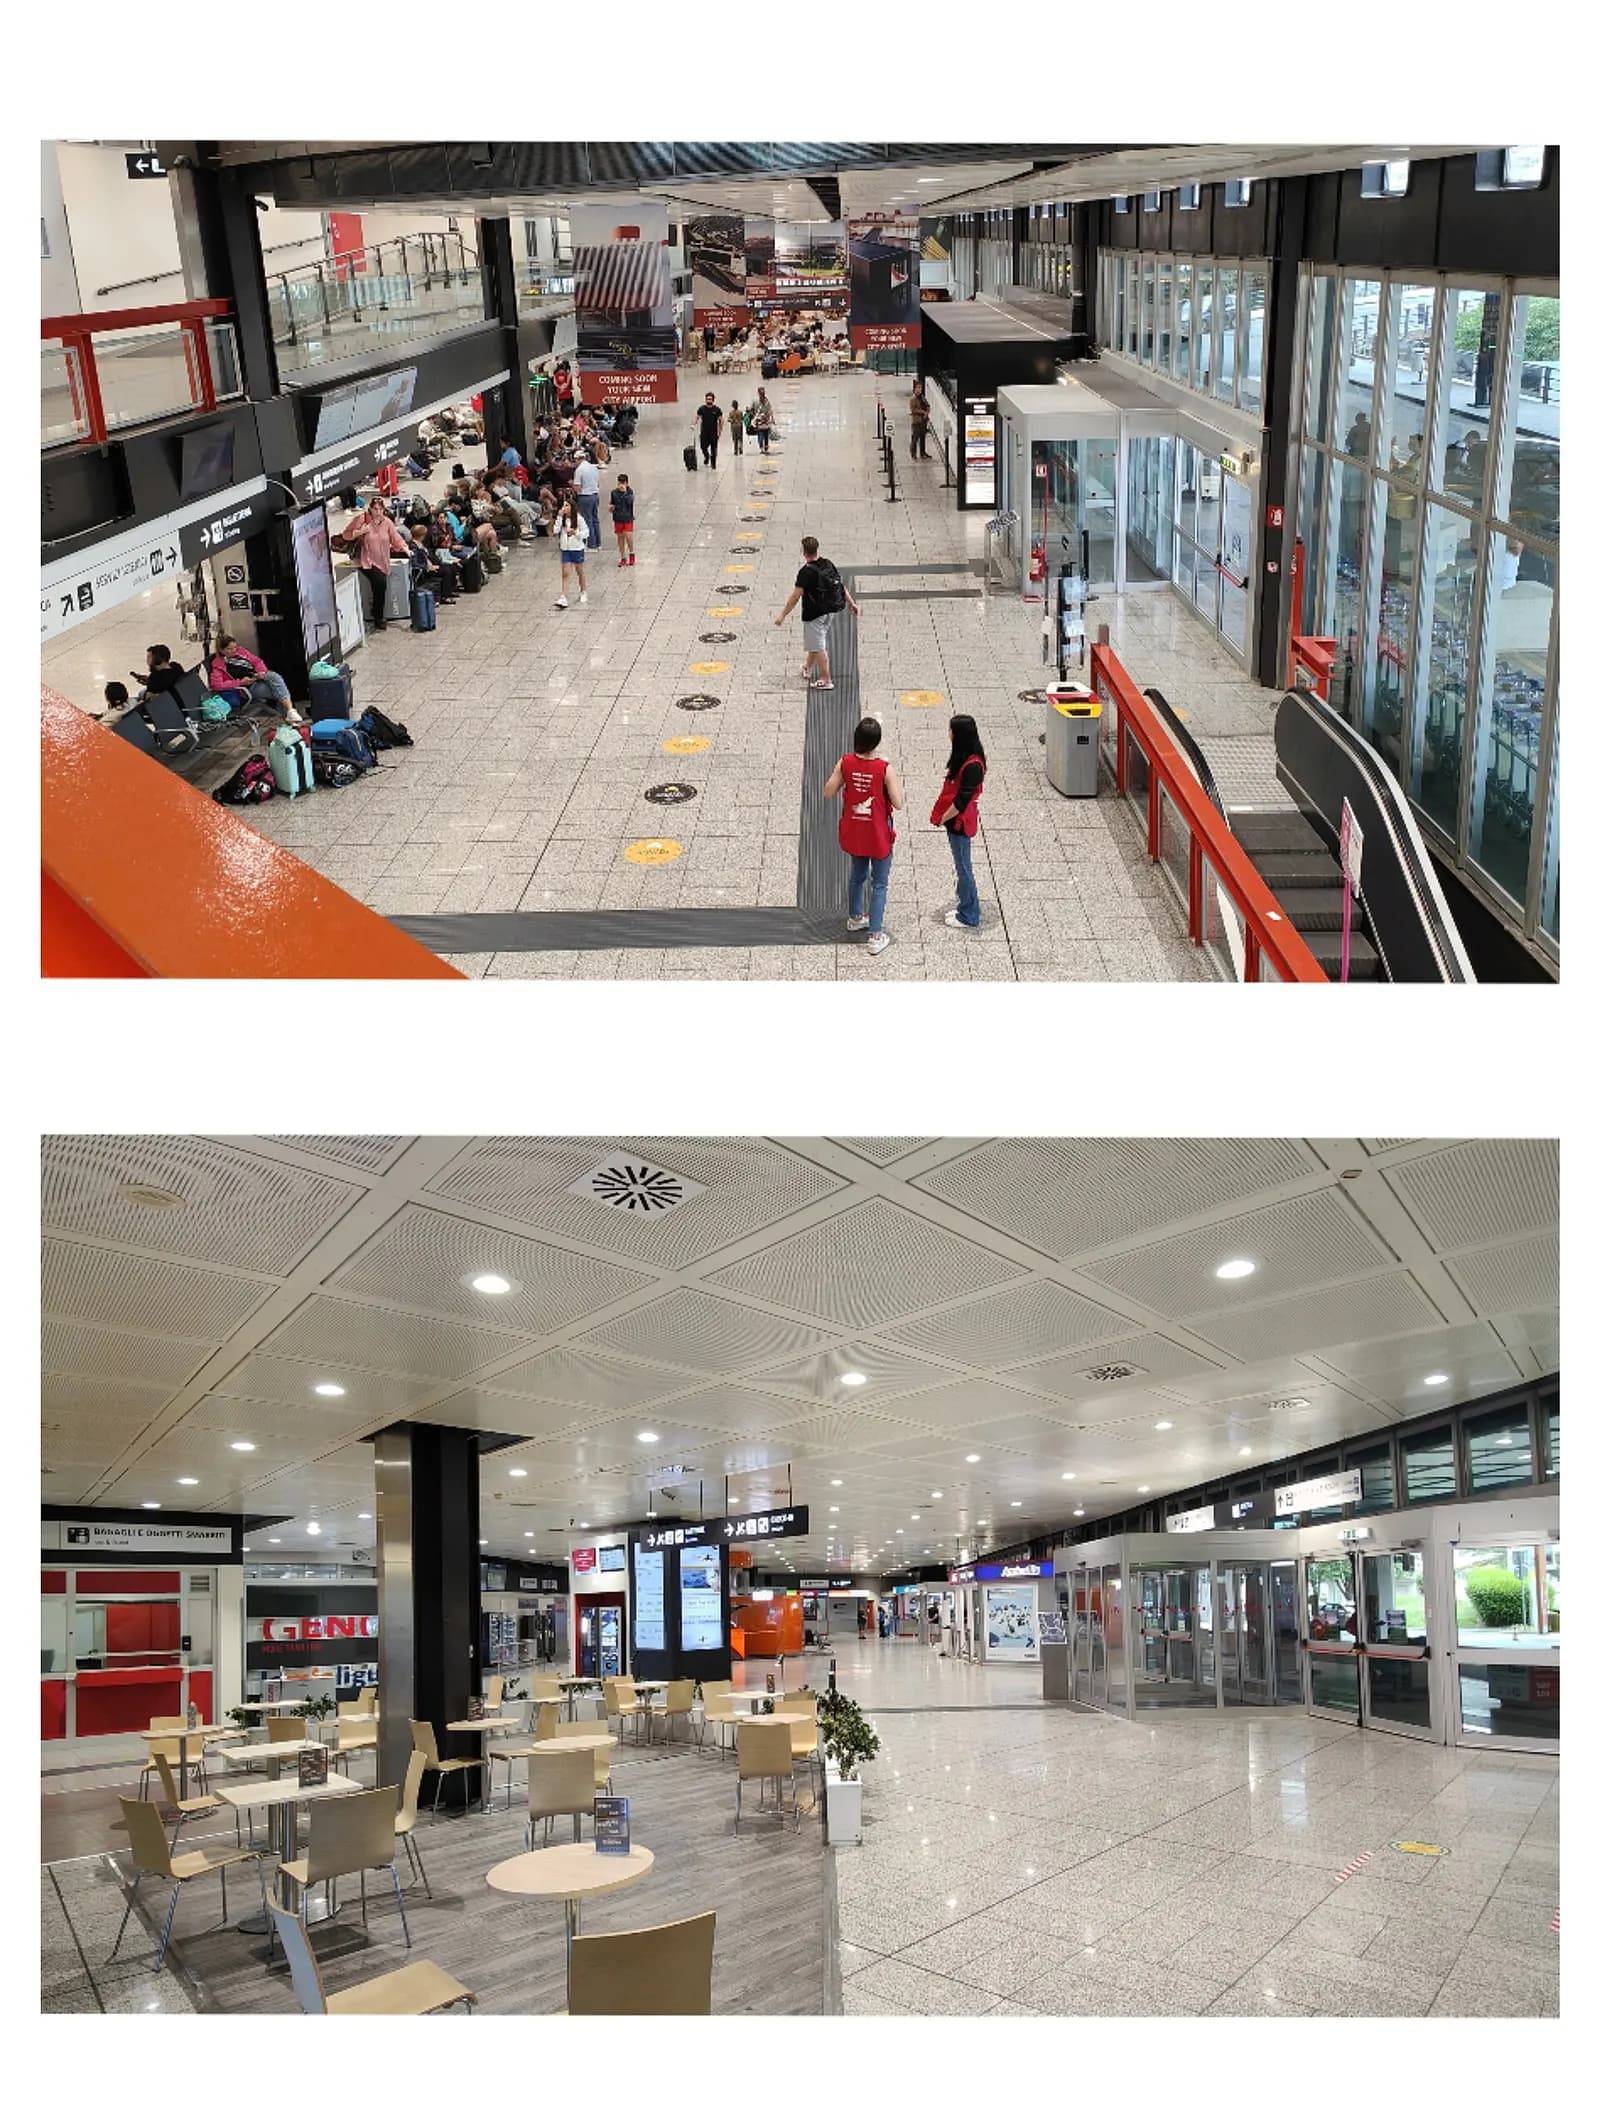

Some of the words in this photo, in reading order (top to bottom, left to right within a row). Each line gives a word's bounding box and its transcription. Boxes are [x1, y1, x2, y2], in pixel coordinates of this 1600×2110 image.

[599, 375, 632, 384] COMING
[634, 374, 658, 383] SOON
[607, 386, 631, 394] YOUR
[632, 384, 651, 393] NEW
[602, 396, 621, 404] CITY
[622, 395, 656, 405] AIRPORT
[94, 1528, 136, 1537] BAGAGLI
[146, 1530, 183, 1539] OGGETTI
[185, 1531, 226, 1539] SMARRITI
